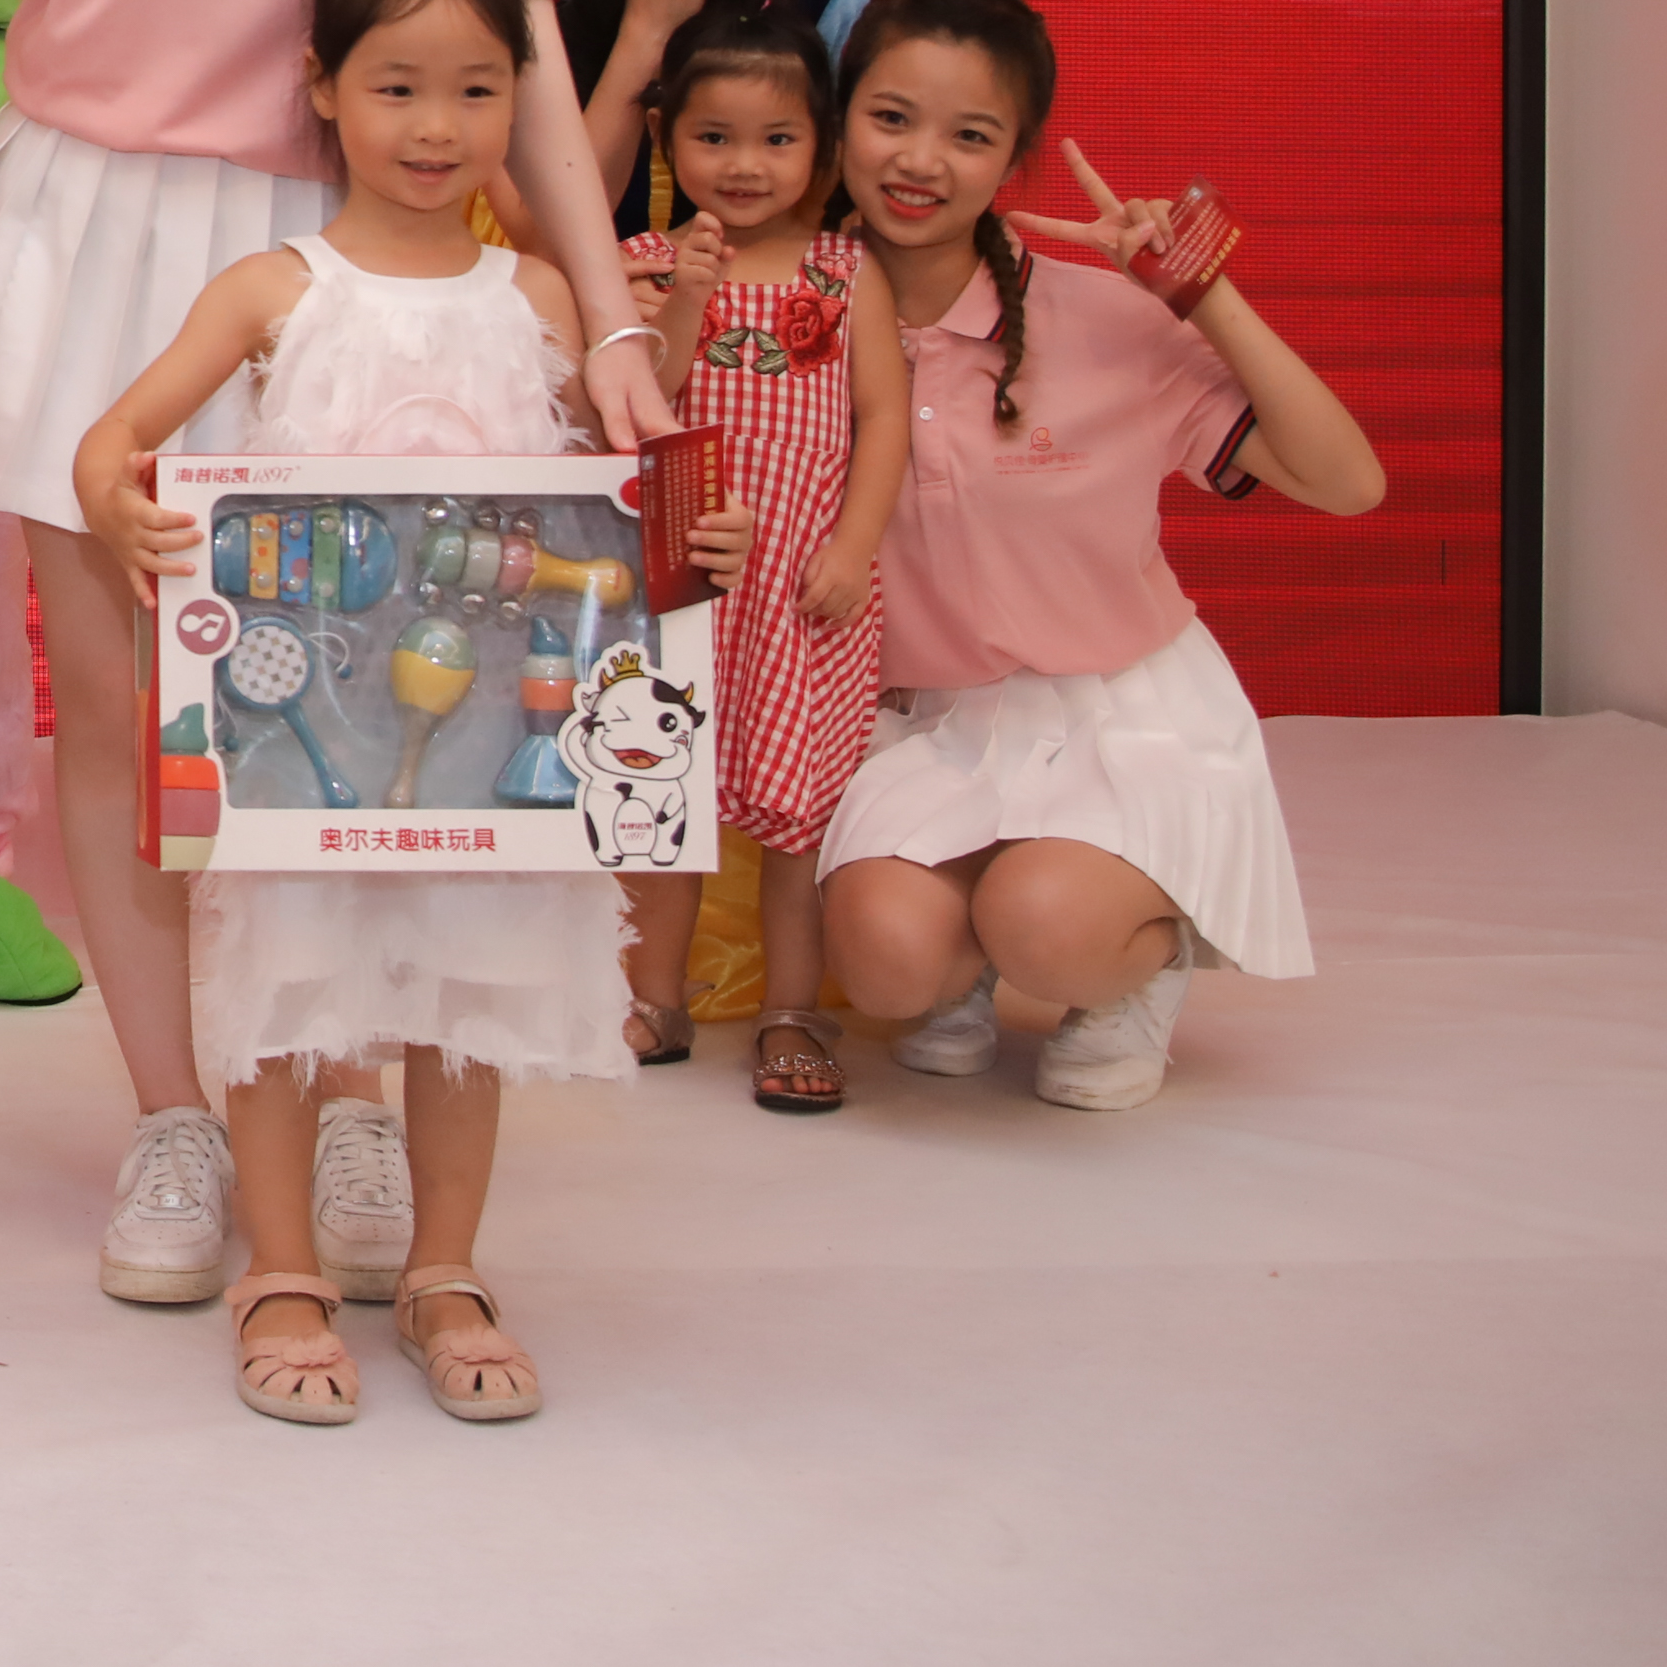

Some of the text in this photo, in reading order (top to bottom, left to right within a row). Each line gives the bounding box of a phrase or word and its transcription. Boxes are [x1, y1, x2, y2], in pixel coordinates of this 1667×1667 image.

[319, 827, 497, 852] 奥尔夫趣味玩具
